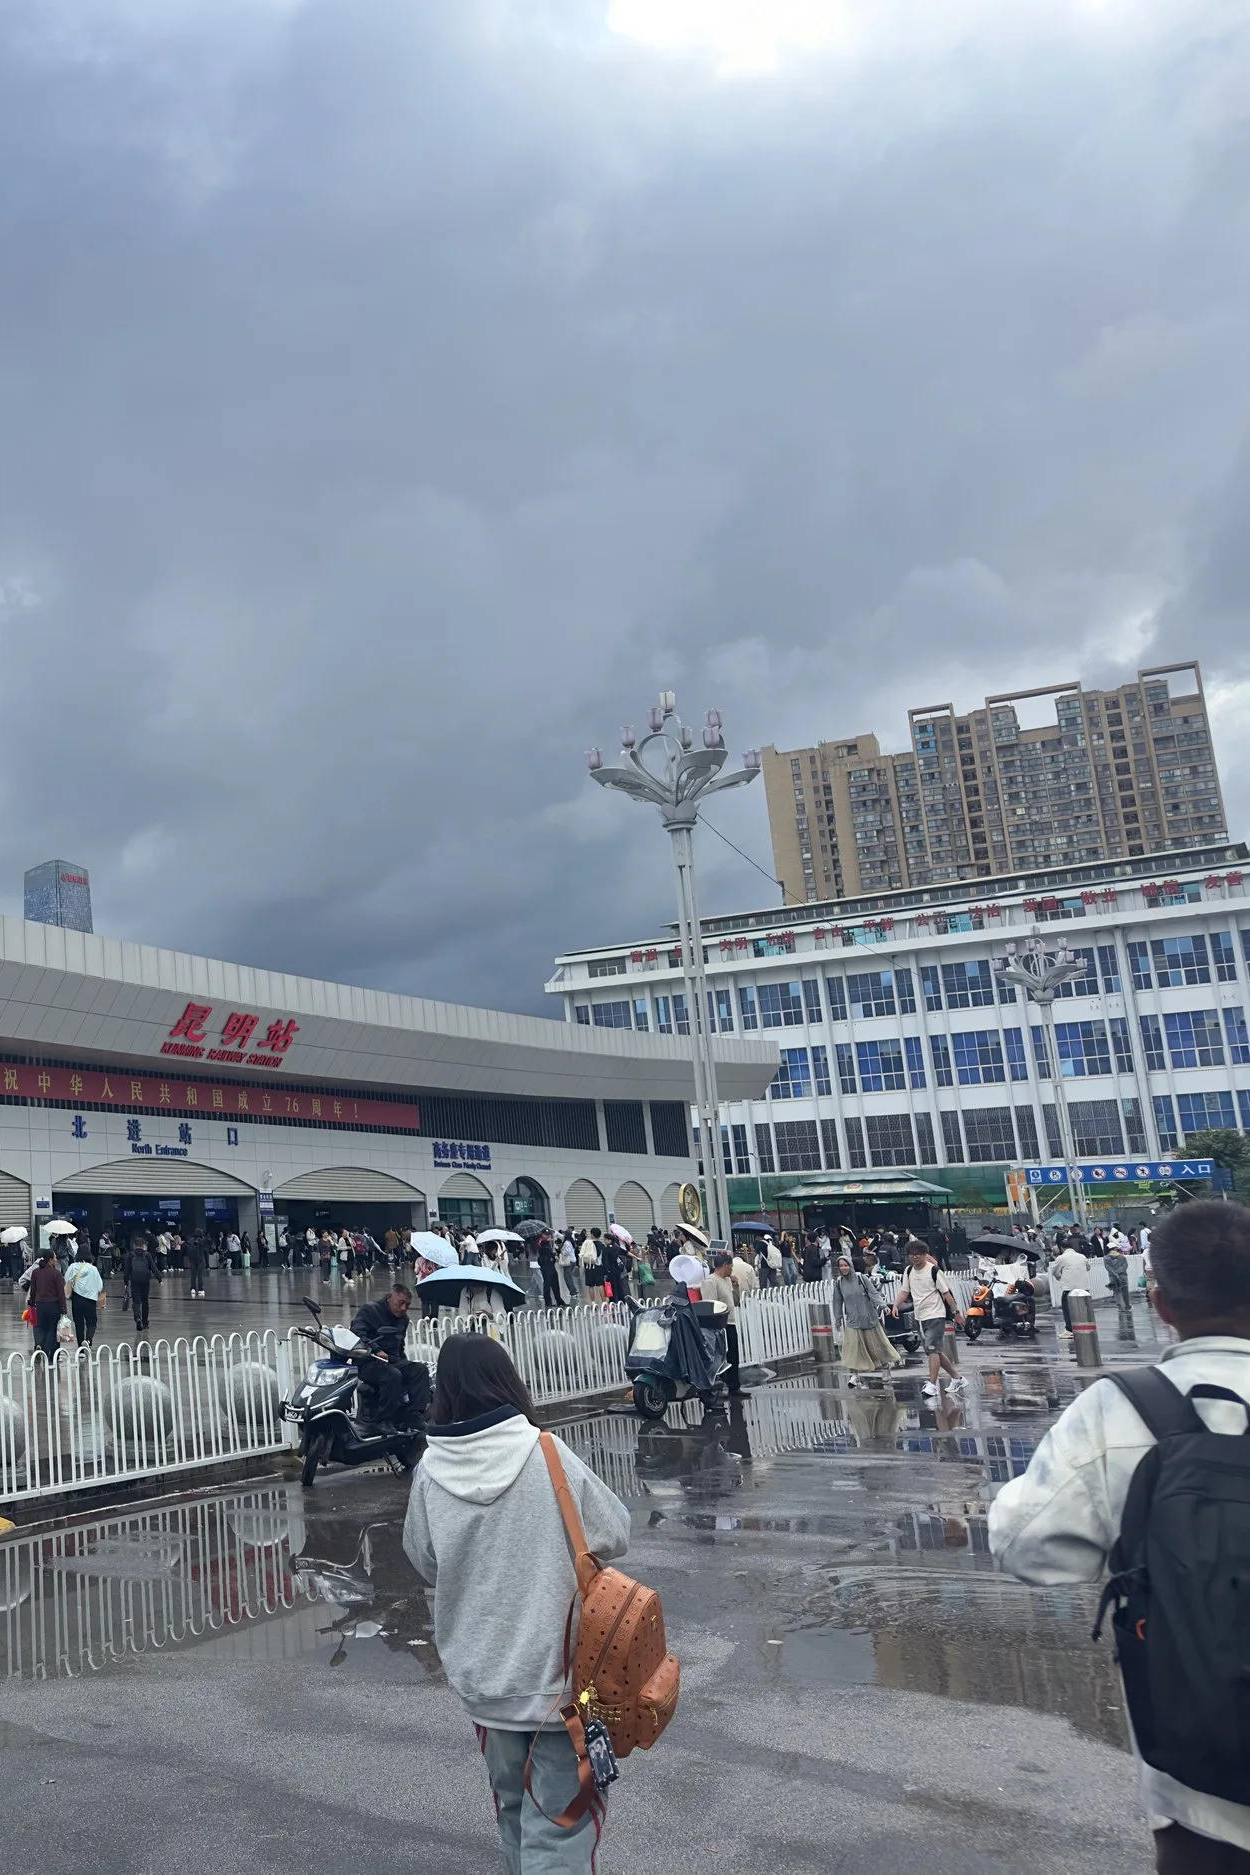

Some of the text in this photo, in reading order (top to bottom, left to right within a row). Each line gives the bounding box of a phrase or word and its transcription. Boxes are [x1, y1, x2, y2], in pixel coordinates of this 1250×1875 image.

[719, 937, 748, 952] 文明
[766, 931, 796, 946] 和谐
[813, 924, 843, 939] 自由
[863, 917, 895, 933] 平等
[915, 910, 947, 926] 公正
[968, 903, 1000, 920] 法治
[1022, 896, 1058, 912] 爱国
[1080, 887, 1118, 905] 敬业
[1141, 879, 1179, 897] 诚信
[1204, 871, 1243, 889] 友善
[170, 1001, 300, 1052] 昆明站
[160, 1041, 283, 1068] KUNMING RAILWAY STATION
[72, 1115, 238, 1146] 北进站口
[132, 1143, 189, 1157] North Entrance
[1181, 1164, 1211, 1175] 入口
